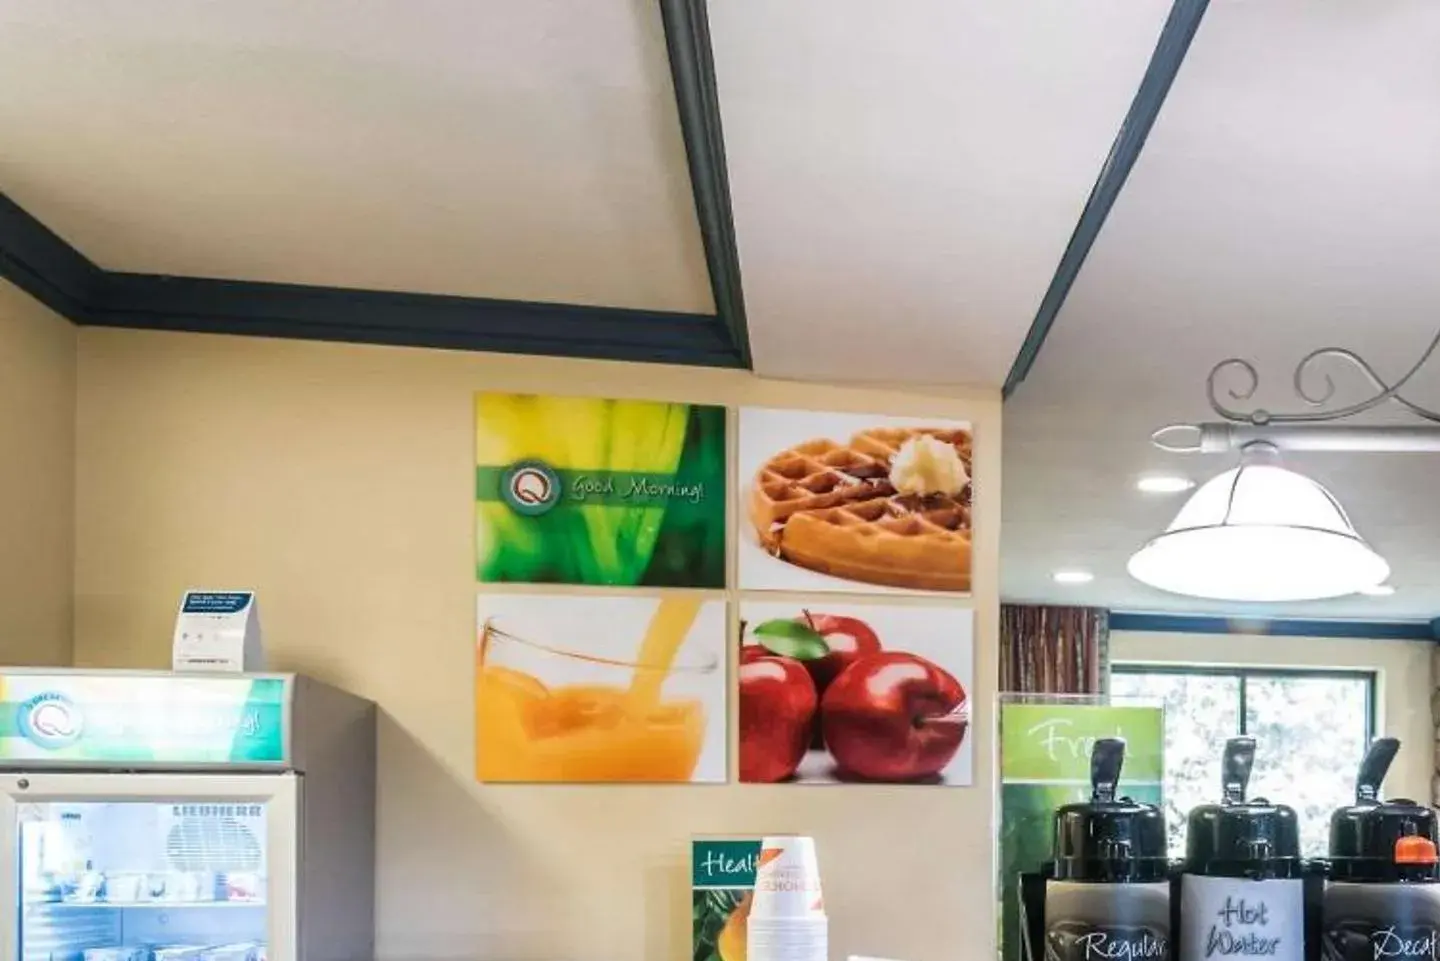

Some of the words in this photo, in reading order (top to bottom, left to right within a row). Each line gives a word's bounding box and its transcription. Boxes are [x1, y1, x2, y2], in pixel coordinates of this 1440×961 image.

[572, 475, 614, 499] Good
[620, 475, 704, 503] Morning!
[1217, 896, 1269, 927] Hot
[1205, 925, 1281, 958] Water
